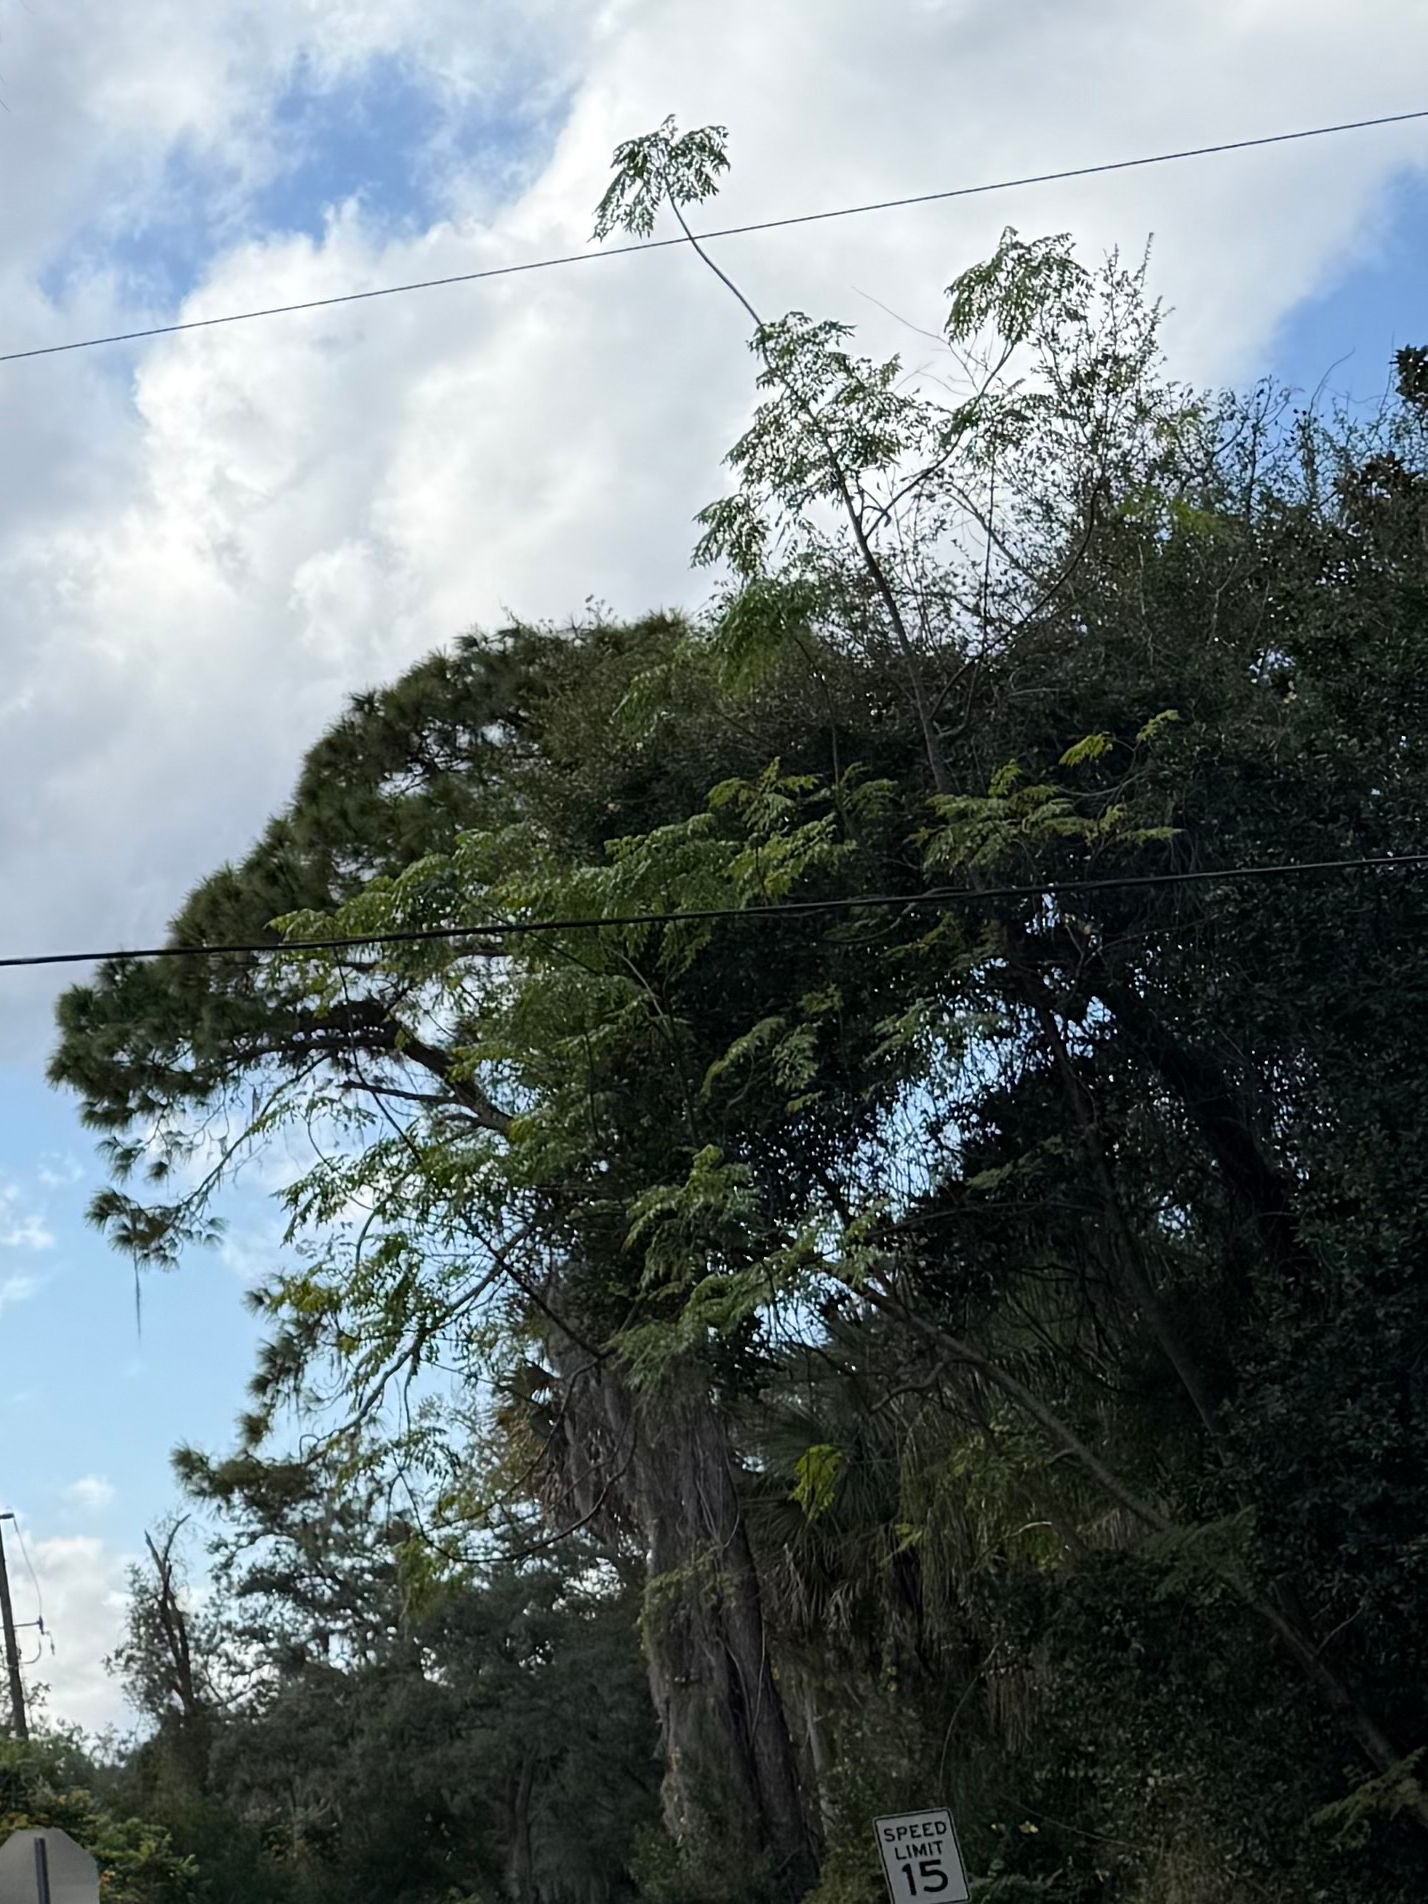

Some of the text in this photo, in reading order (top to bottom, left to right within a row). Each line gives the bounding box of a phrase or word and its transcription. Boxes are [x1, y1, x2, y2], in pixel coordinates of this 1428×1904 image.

[884, 1821, 947, 1842] SPEED
[894, 1840, 943, 1860] LIMIT
[901, 1859, 948, 1896] 15
